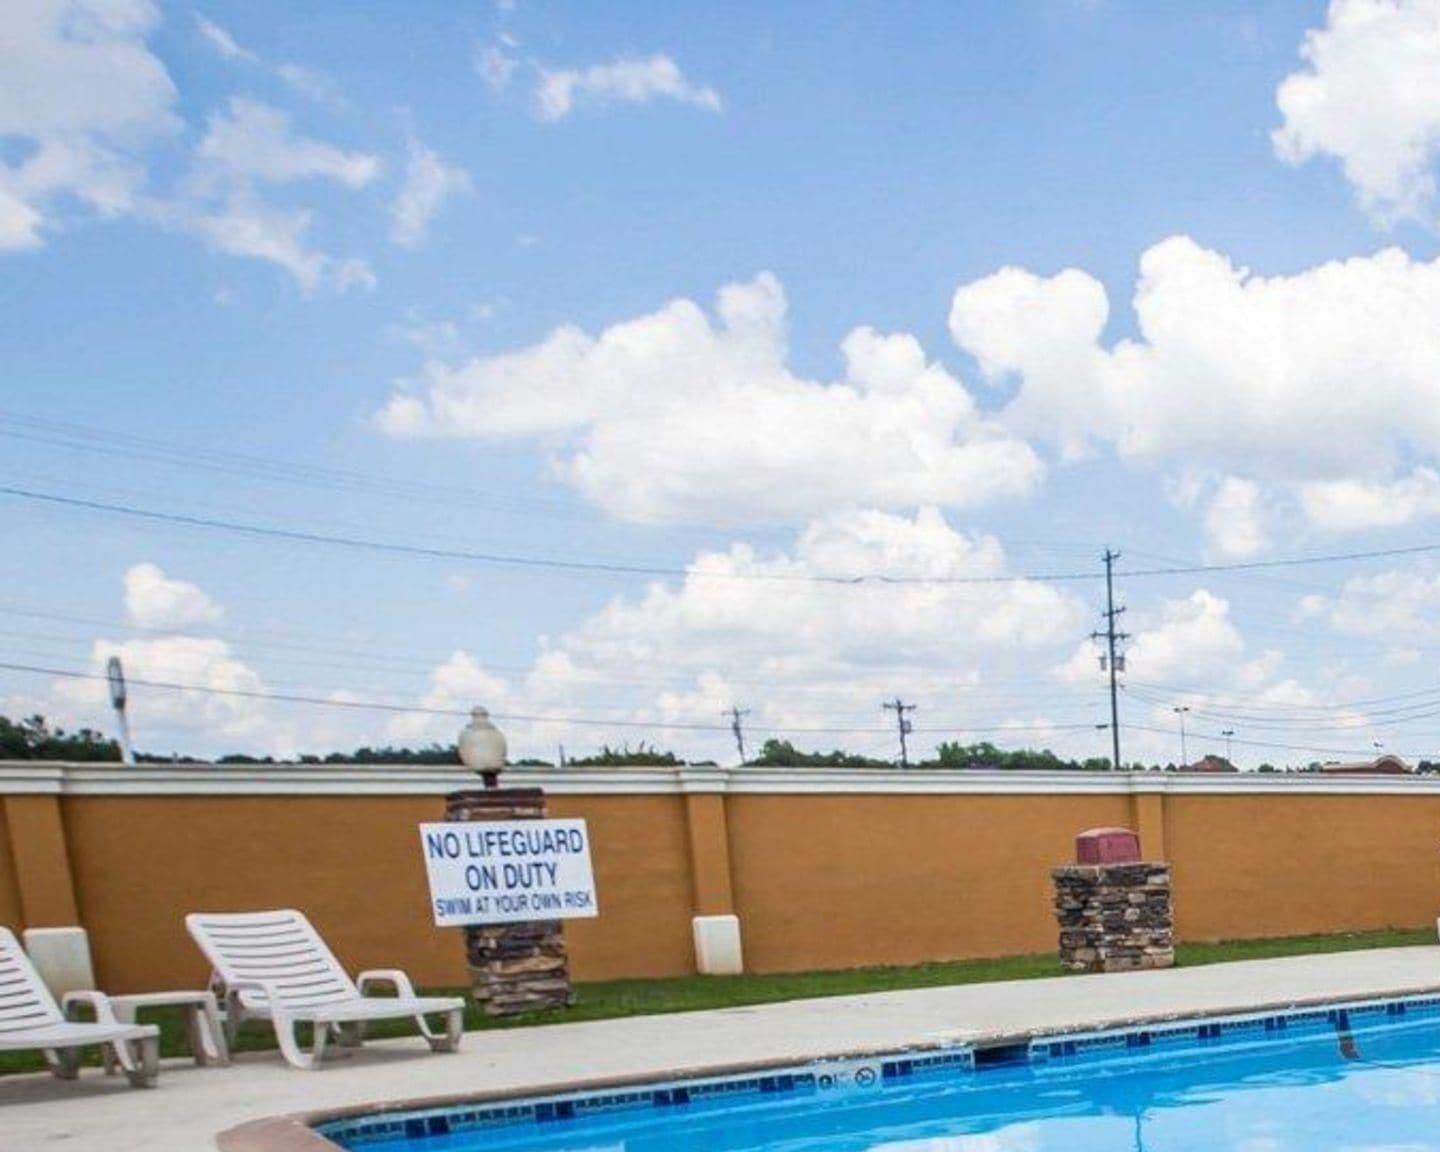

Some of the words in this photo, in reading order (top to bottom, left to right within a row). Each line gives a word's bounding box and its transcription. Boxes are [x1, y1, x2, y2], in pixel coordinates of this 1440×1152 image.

[427, 832, 460, 859] NO
[464, 829, 584, 858] LIFEGUARD
[465, 864, 498, 891] ON
[502, 862, 558, 889] DUTY
[436, 897, 472, 917] SWIM
[476, 896, 490, 914] AT
[494, 894, 528, 913] YOUR
[531, 892, 562, 911] OWN
[564, 890, 593, 909] RISK
